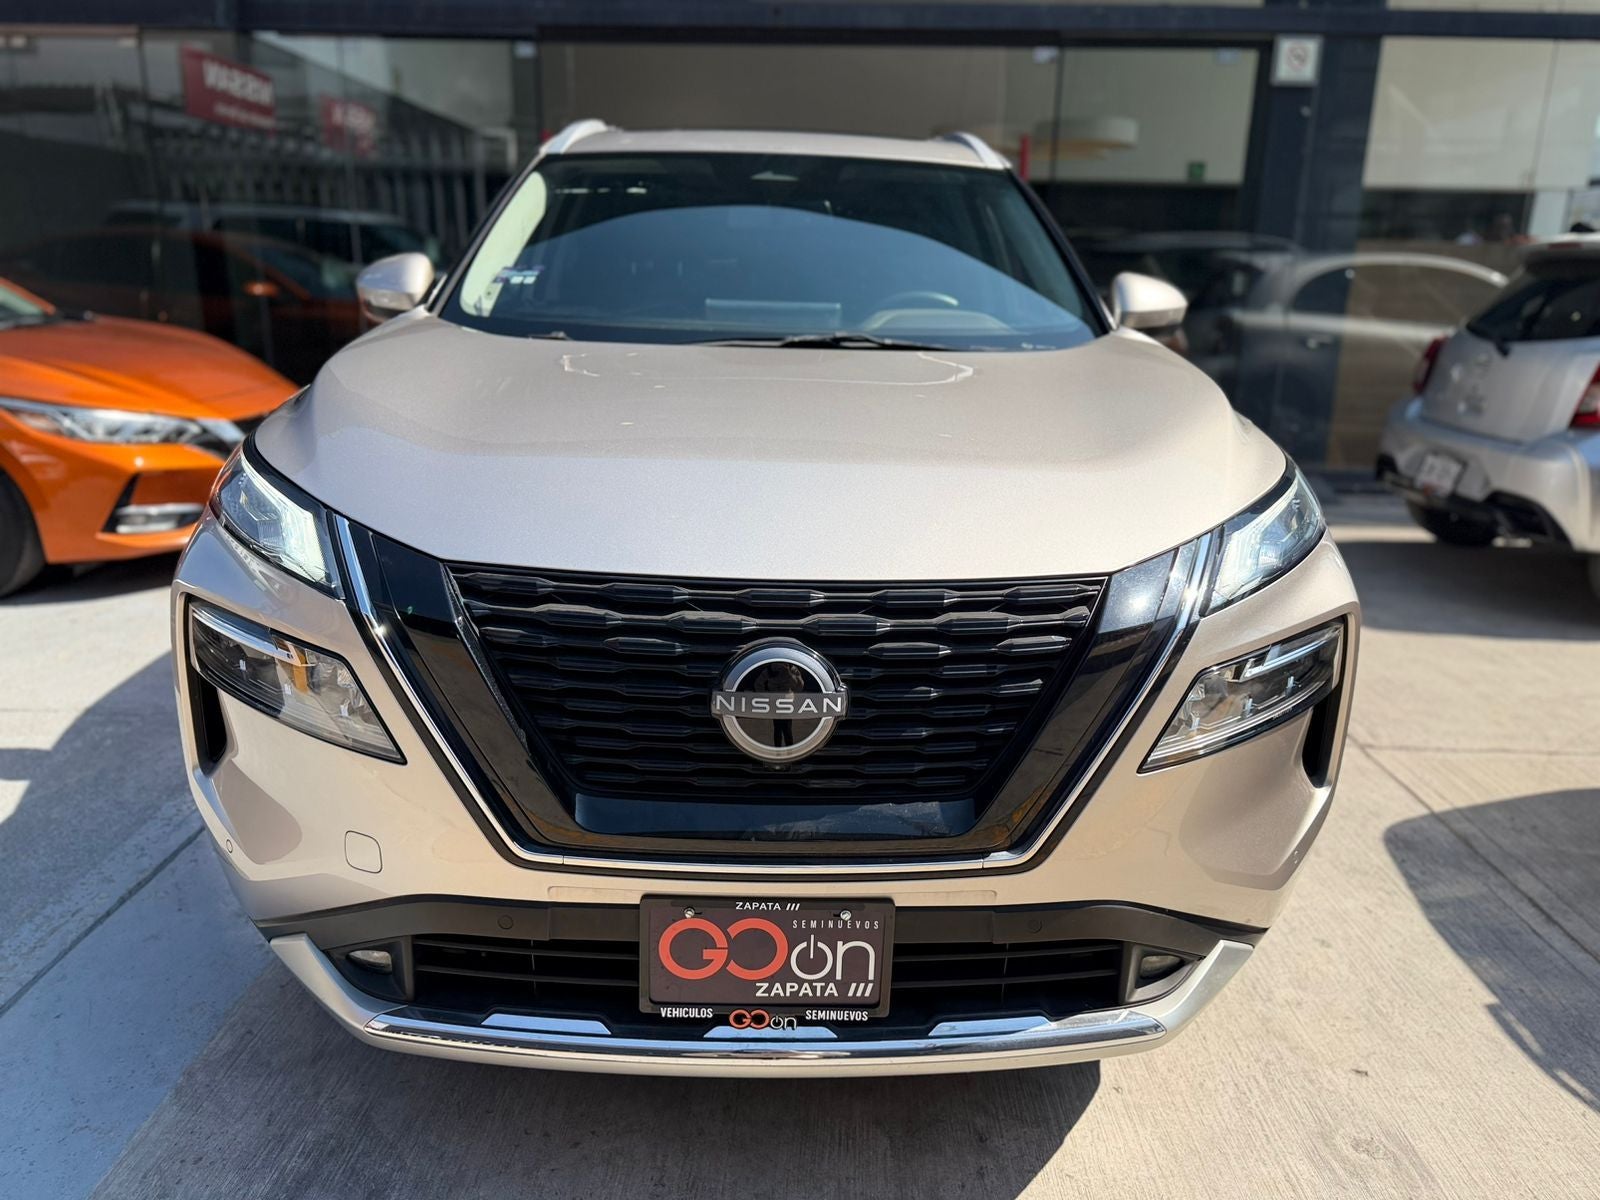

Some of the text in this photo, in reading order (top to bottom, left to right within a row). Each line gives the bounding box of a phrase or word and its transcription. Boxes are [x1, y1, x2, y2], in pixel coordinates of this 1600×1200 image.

[715, 695, 842, 714] NISSAN
[735, 901, 782, 911] ZAPATA
[792, 919, 879, 930] SEMINUEVOS
[755, 982, 839, 997] ZAPATA
[660, 1007, 713, 1019] VEHICULOS
[805, 1009, 869, 1022] SEMINUEVOS
